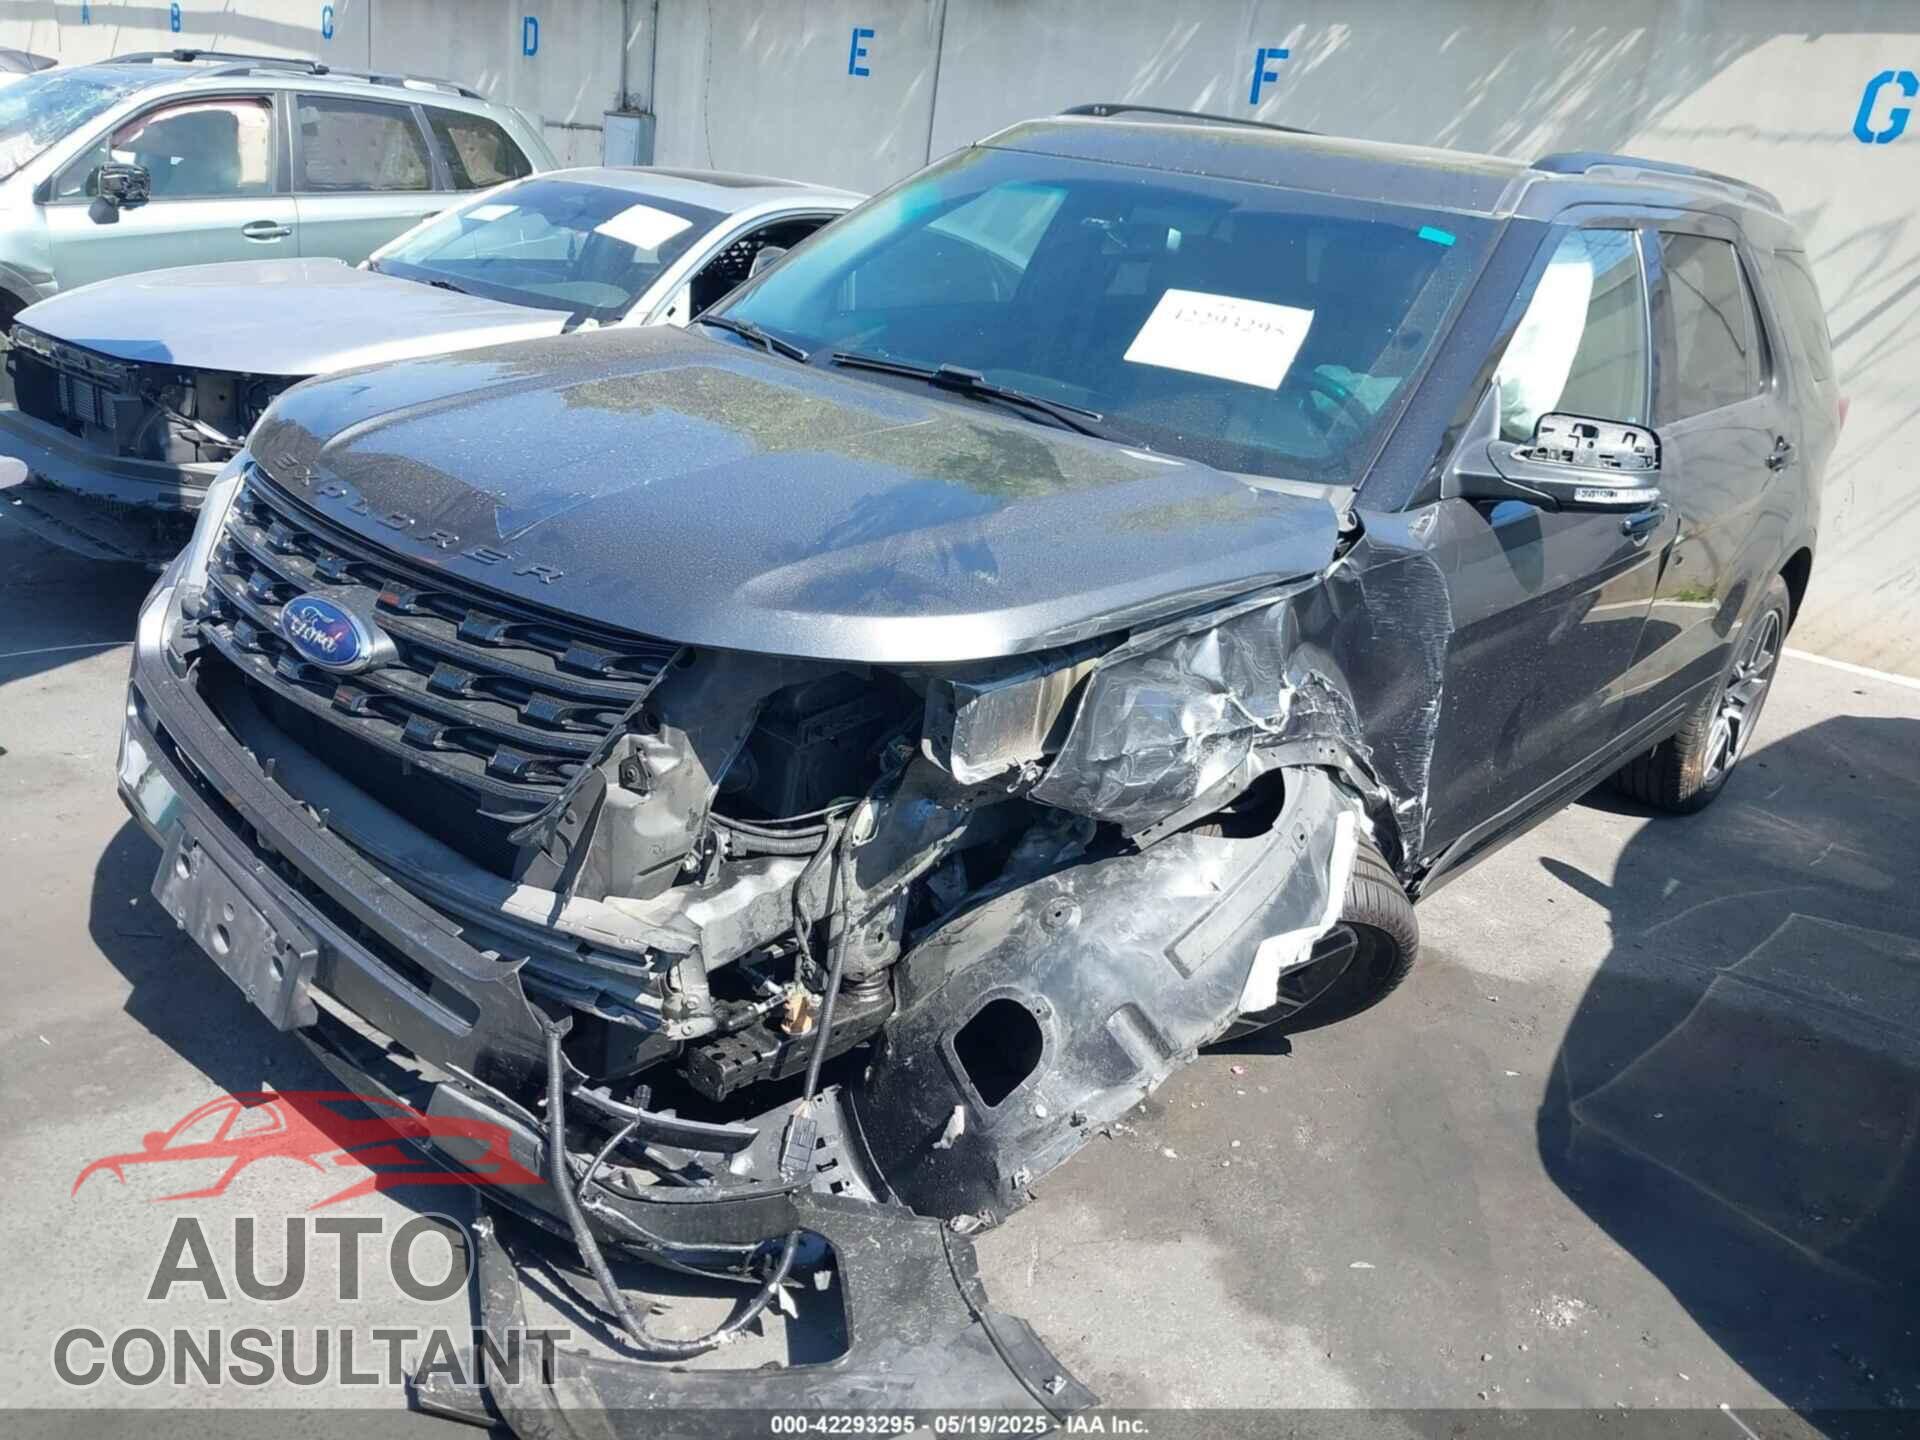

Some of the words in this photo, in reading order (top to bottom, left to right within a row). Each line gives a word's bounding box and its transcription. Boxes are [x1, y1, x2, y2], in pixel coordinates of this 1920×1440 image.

[170, 3, 181, 33] B
[322, 5, 334, 40] C
[523, 16, 539, 56] D
[848, 28, 875, 76] E
[1249, 47, 1289, 105] F
[1853, 70, 1920, 144] G
[274, 453, 565, 585] EXPLORER
[285, 605, 343, 654] Ford
